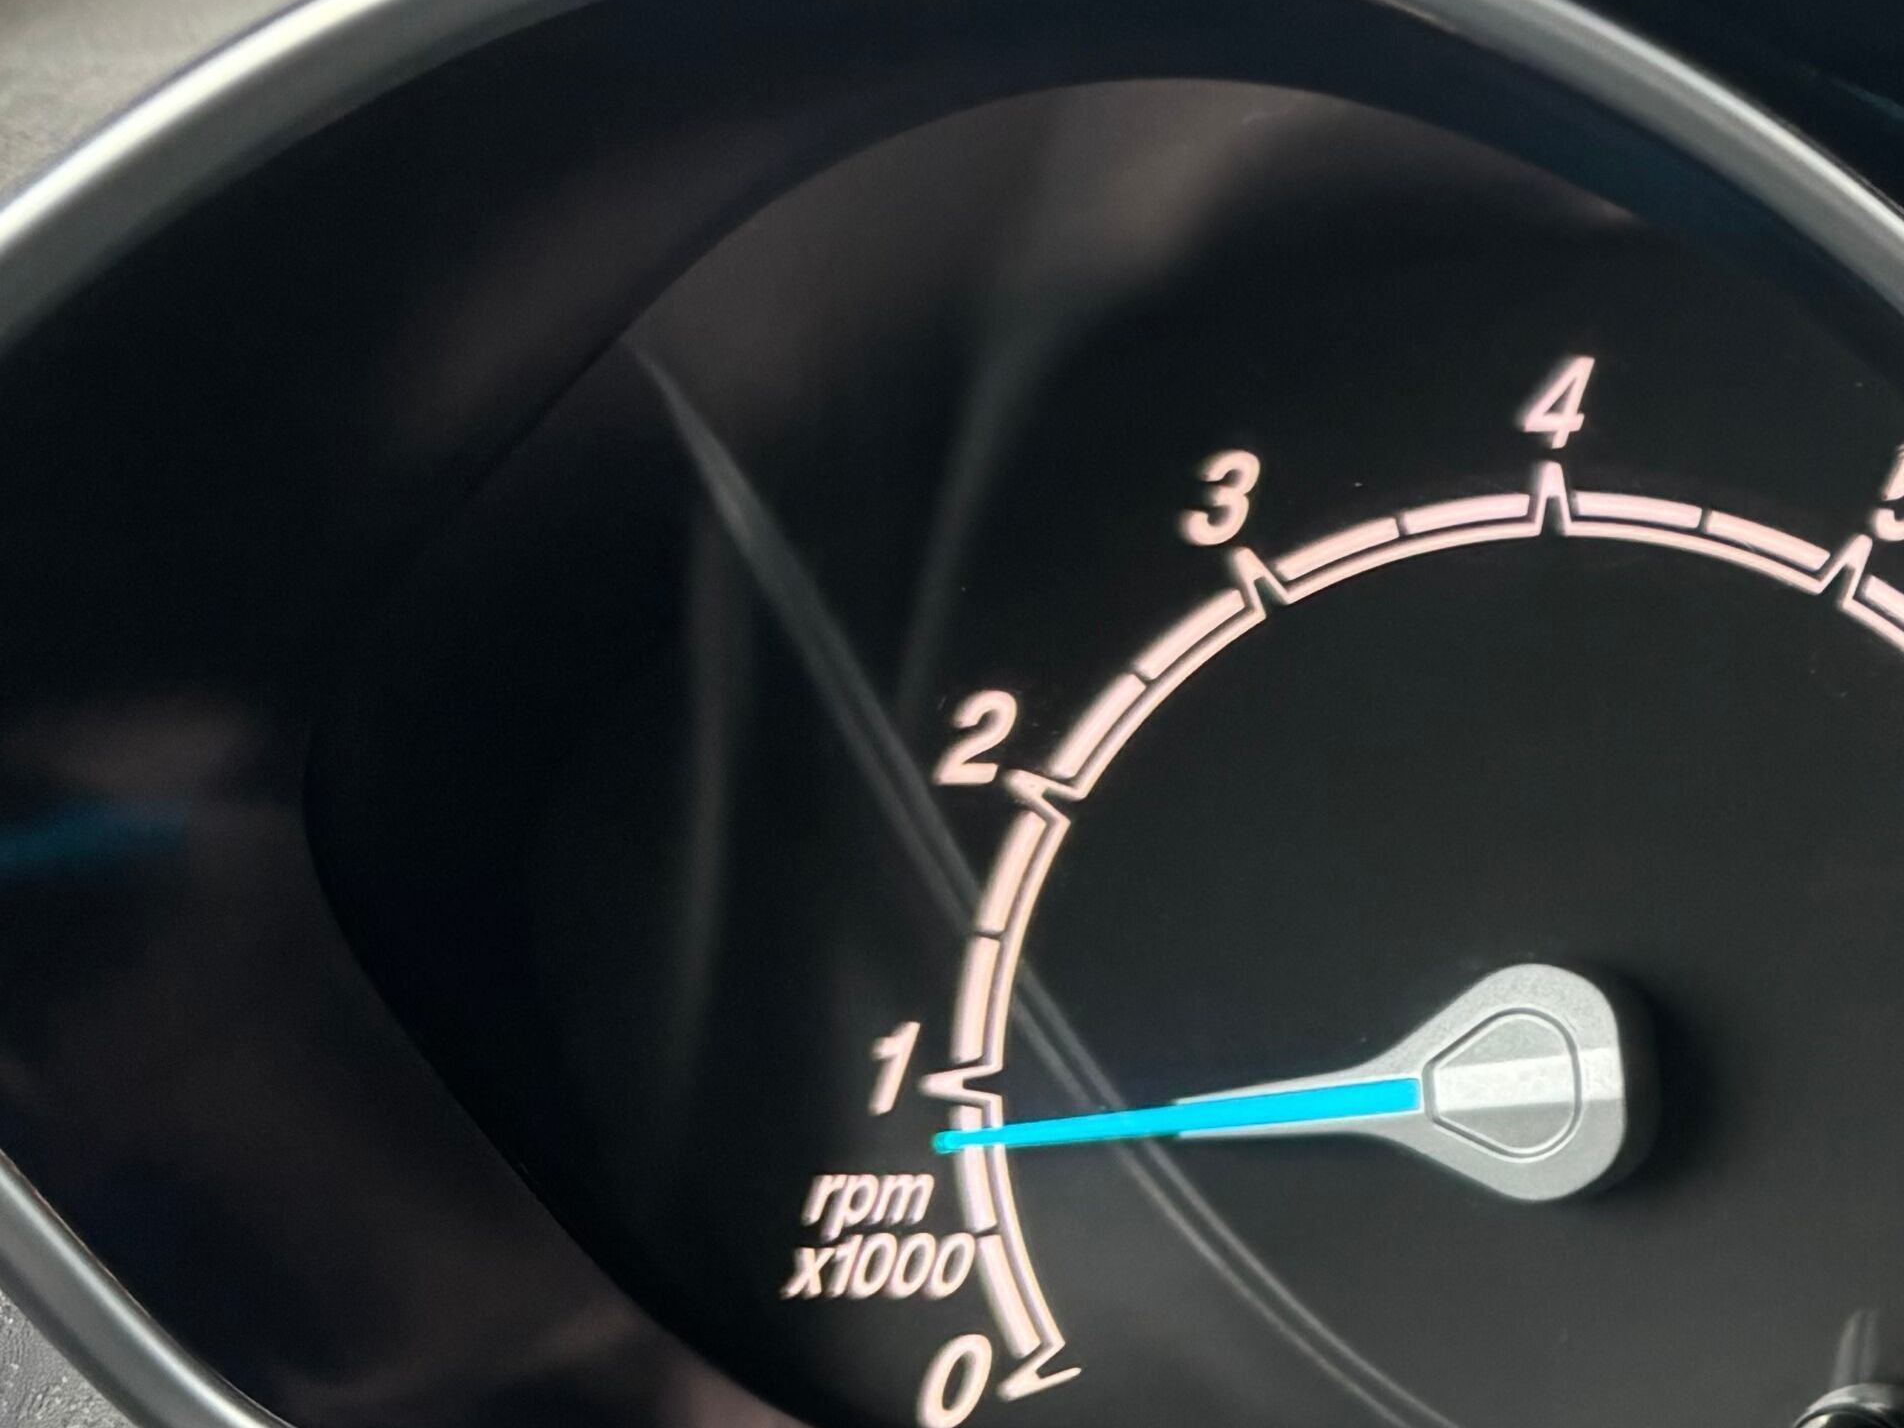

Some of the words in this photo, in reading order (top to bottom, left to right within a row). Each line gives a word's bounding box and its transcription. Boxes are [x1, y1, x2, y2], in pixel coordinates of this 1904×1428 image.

[1517, 356, 1595, 449] 4
[1180, 449, 1261, 546] 3
[933, 689, 1018, 785] 2
[869, 1021, 920, 1115] 1
[802, 1174, 934, 1239] rpm
[781, 1232, 976, 1299] x1000
